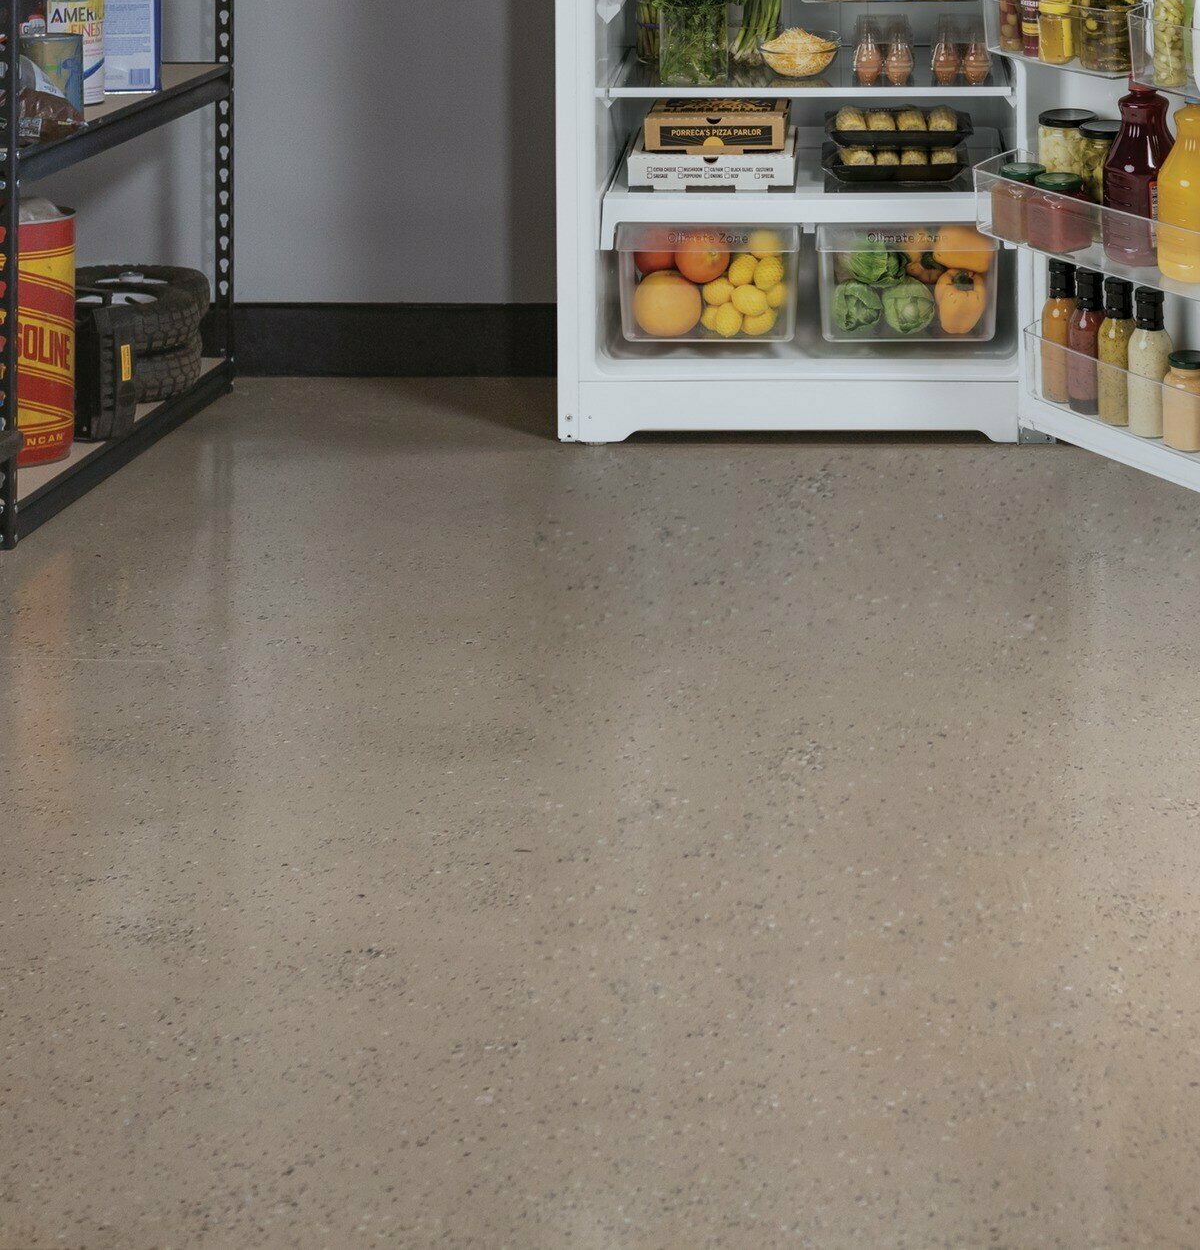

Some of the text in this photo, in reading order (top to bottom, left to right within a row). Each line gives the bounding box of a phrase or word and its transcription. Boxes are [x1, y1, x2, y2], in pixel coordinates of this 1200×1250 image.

[50, 6, 99, 25] AMERI
[671, 128, 762, 137] PORRECA'S PIZZA PARLOR
[668, 231, 749, 244] Climate Zone
[867, 232, 915, 243] Climate
[17, 322, 71, 371] SOLINE
